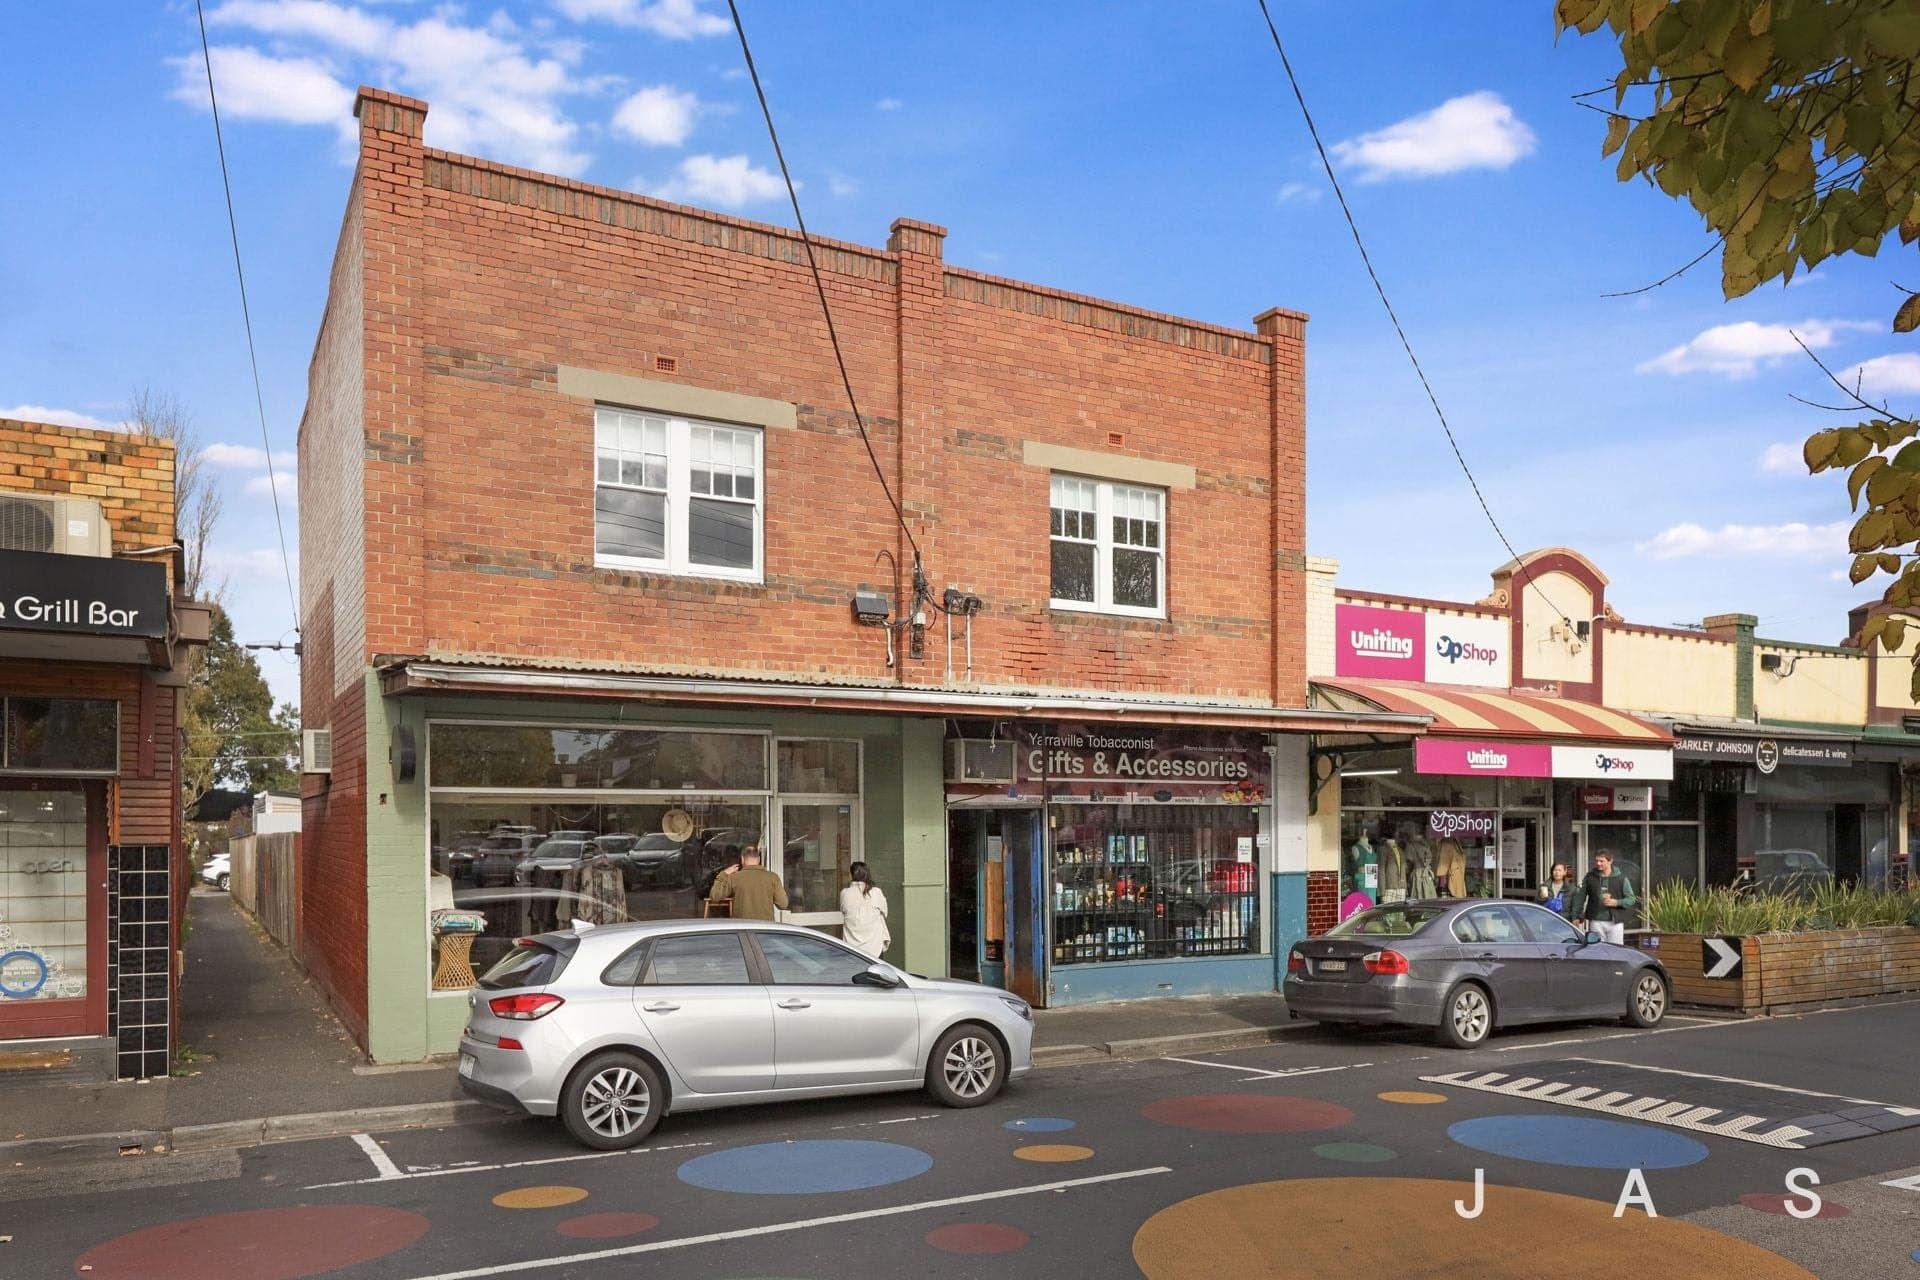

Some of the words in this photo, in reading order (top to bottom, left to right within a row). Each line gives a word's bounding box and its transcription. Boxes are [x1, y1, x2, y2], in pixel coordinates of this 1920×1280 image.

[14, 596, 79, 623] Grill
[88, 601, 139, 627] Bar
[1351, 628, 1413, 659] Uniting
[1086, 735, 1154, 750] Tobacconist
[1716, 742, 1753, 754] JOHNSON
[1782, 746, 1824, 757] delicatessen
[1826, 749, 1830, 758] &
[1832, 750, 1847, 759] wine
[1028, 750, 1085, 775] Gifts
[1092, 751, 1109, 775] &
[1116, 752, 1248, 779] Accessories
[1467, 749, 1507, 769] Uniting
[23, 861, 74, 883] open
